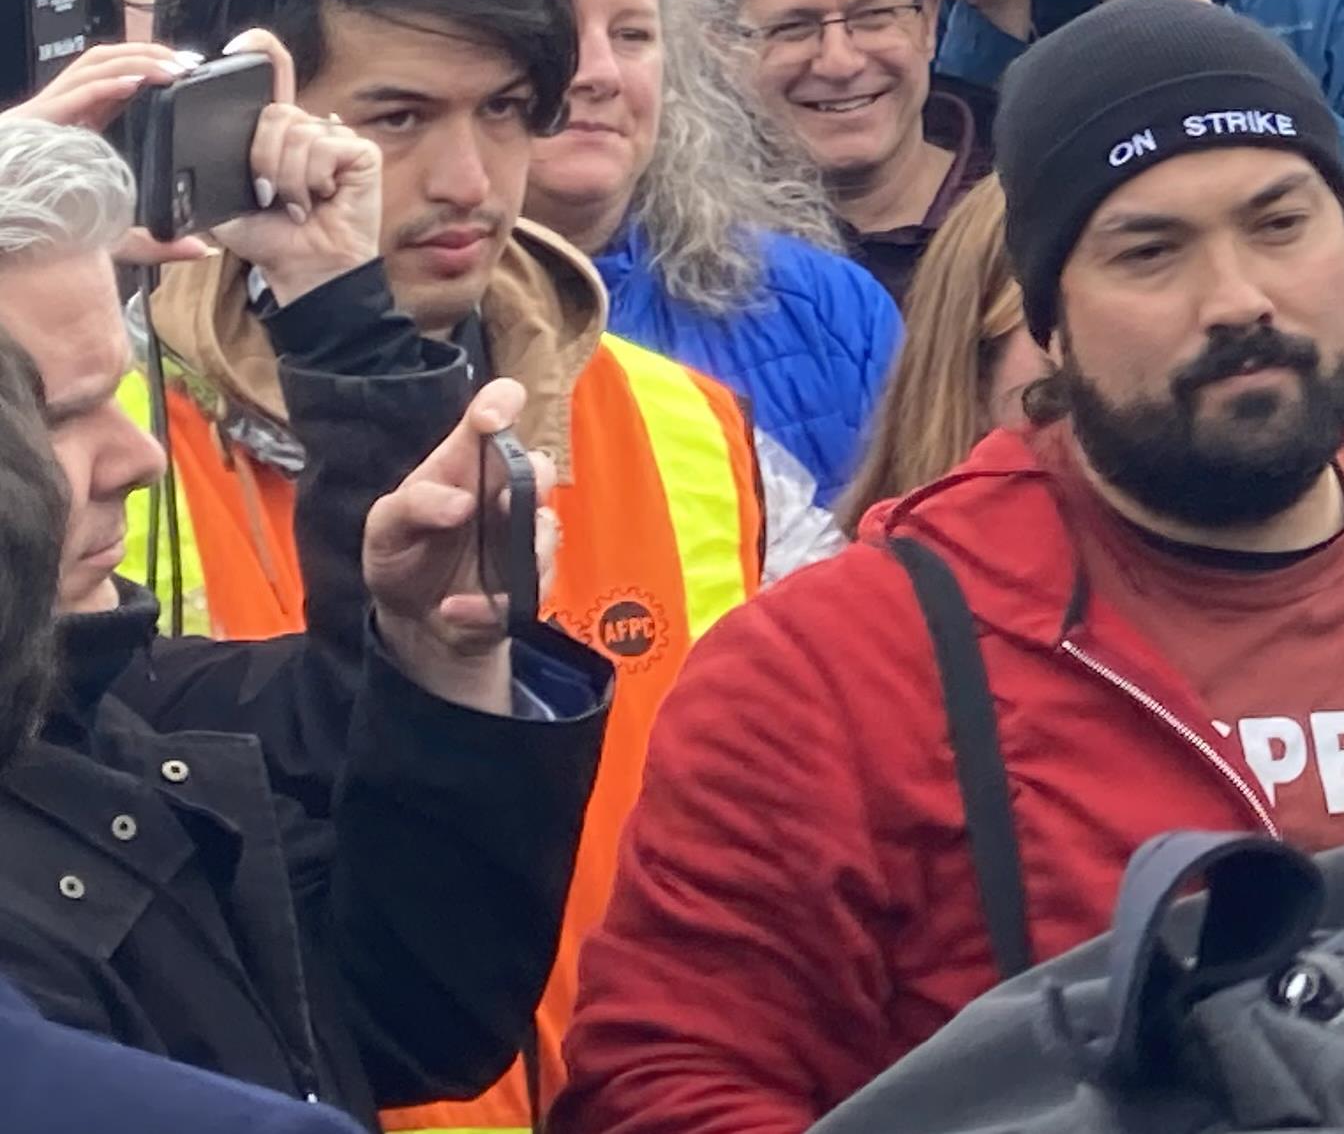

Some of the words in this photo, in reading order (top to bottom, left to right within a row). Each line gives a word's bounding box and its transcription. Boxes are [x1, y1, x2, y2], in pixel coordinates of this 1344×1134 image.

[1109, 129, 1157, 167] ON
[1183, 111, 1296, 137] STRIKE
[605, 616, 655, 644] AFPC
